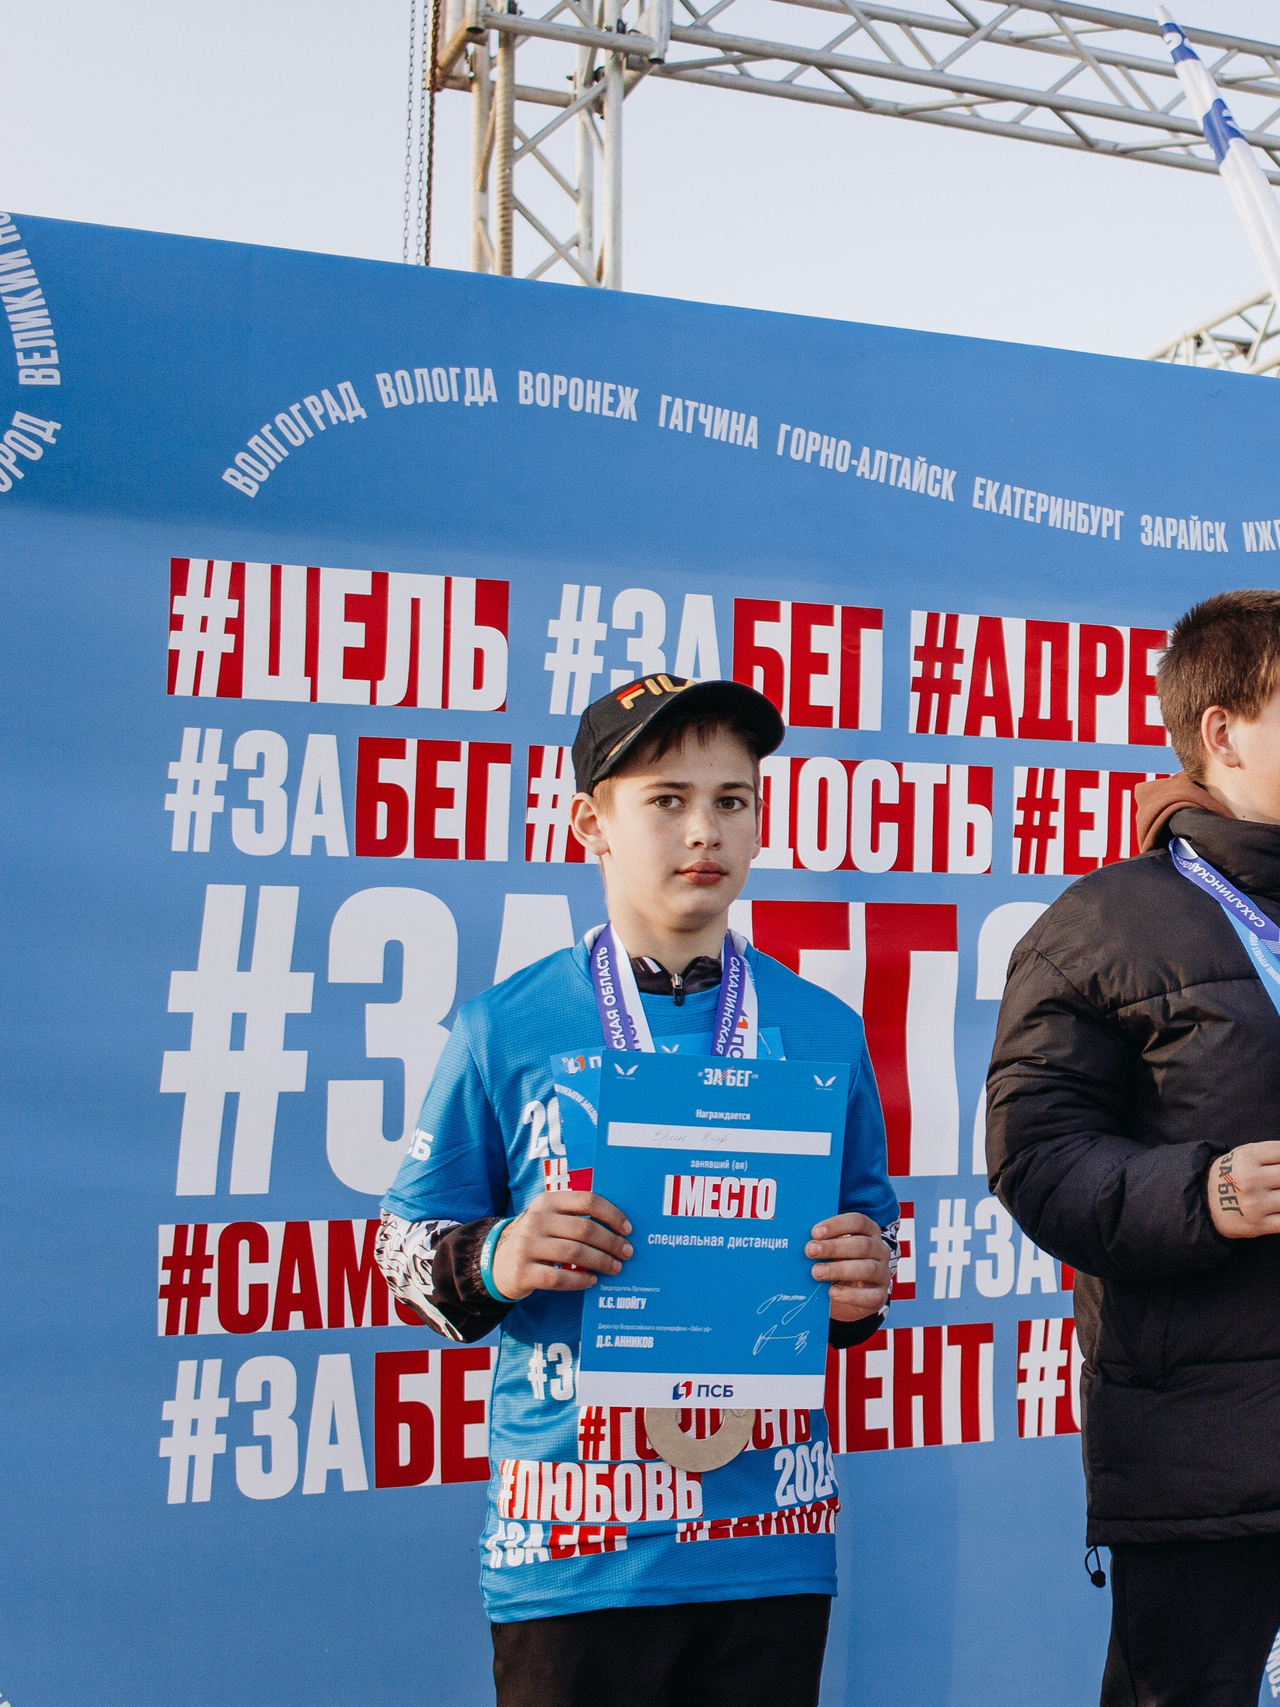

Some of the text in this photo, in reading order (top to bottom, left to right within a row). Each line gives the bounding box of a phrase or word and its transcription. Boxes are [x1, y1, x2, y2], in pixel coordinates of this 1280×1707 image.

[221, 381, 367, 497] ВОЛГОГРАД
[375, 367, 498, 408] ВОЛОГДА
[518, 370, 639, 422] ВОРОНЕЖ
[658, 394, 758, 449] ГАТЧИНА
[777, 423, 957, 502] ГОРНО-АЛТАЙСК
[972, 477, 1124, 540] ЕКАТЕРИНБУРГ
[1140, 514, 1229, 553] ЗАРАЙСК
[167, 559, 509, 712] #ЦЕЛЬ
[616, 674, 698, 710] FIL
[164, 727, 511, 862] #ЗАБЕГ
[597, 946, 616, 1007] ОБЛАСТЬ
[716, 956, 741, 1056] САХАЛИНСКАЯ
[695, 1108, 751, 1122] Награждается
[690, 1159, 748, 1172] занявший (ая)
[677, 1175, 778, 1219] МЕСТО
[647, 1232, 789, 1250] специальная дистанция
[616, 1295, 647, 1310] ШОЙГУ
[614, 1335, 655, 1348] АННИКОВ
[697, 1384, 734, 1398] ПСБ
[158, 1346, 498, 1505] #ЗАБЕ
[498, 1459, 704, 1522] #ЛЮБОВЬ
